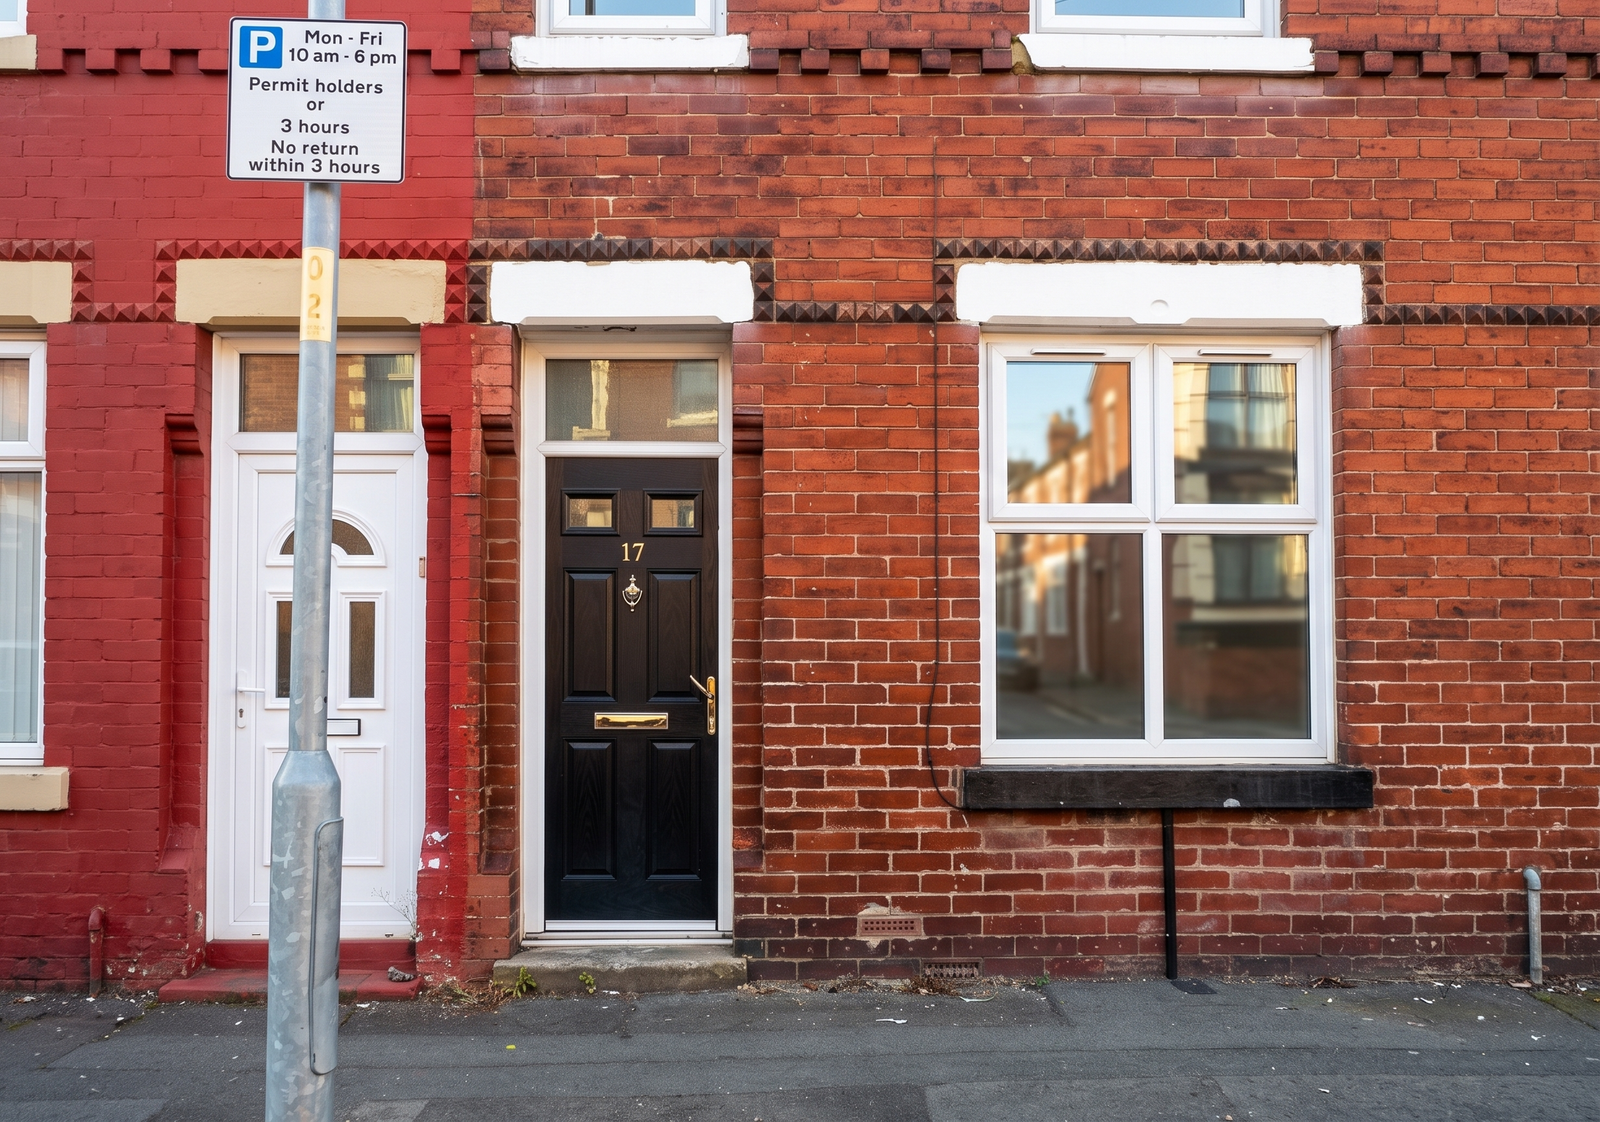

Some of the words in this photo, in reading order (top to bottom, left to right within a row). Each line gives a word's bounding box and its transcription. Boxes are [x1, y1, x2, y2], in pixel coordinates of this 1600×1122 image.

[305, 29, 343, 45] Mon
[360, 31, 383, 46] Fri
[249, 30, 277, 64] P
[289, 47, 309, 62] 10
[313, 51, 339, 63] am
[354, 49, 365, 64] 6
[370, 53, 397, 67] pm
[249, 76, 309, 92] Permit
[315, 79, 384, 94] holders
[306, 100, 325, 111] or
[280, 118, 292, 133] 3
[298, 119, 350, 135] hours
[271, 139, 296, 155] No
[302, 141, 359, 156] return
[248, 158, 304, 172] within
[311, 158, 323, 173] 3
[329, 159, 381, 175] hours
[621, 542, 645, 562] 17
